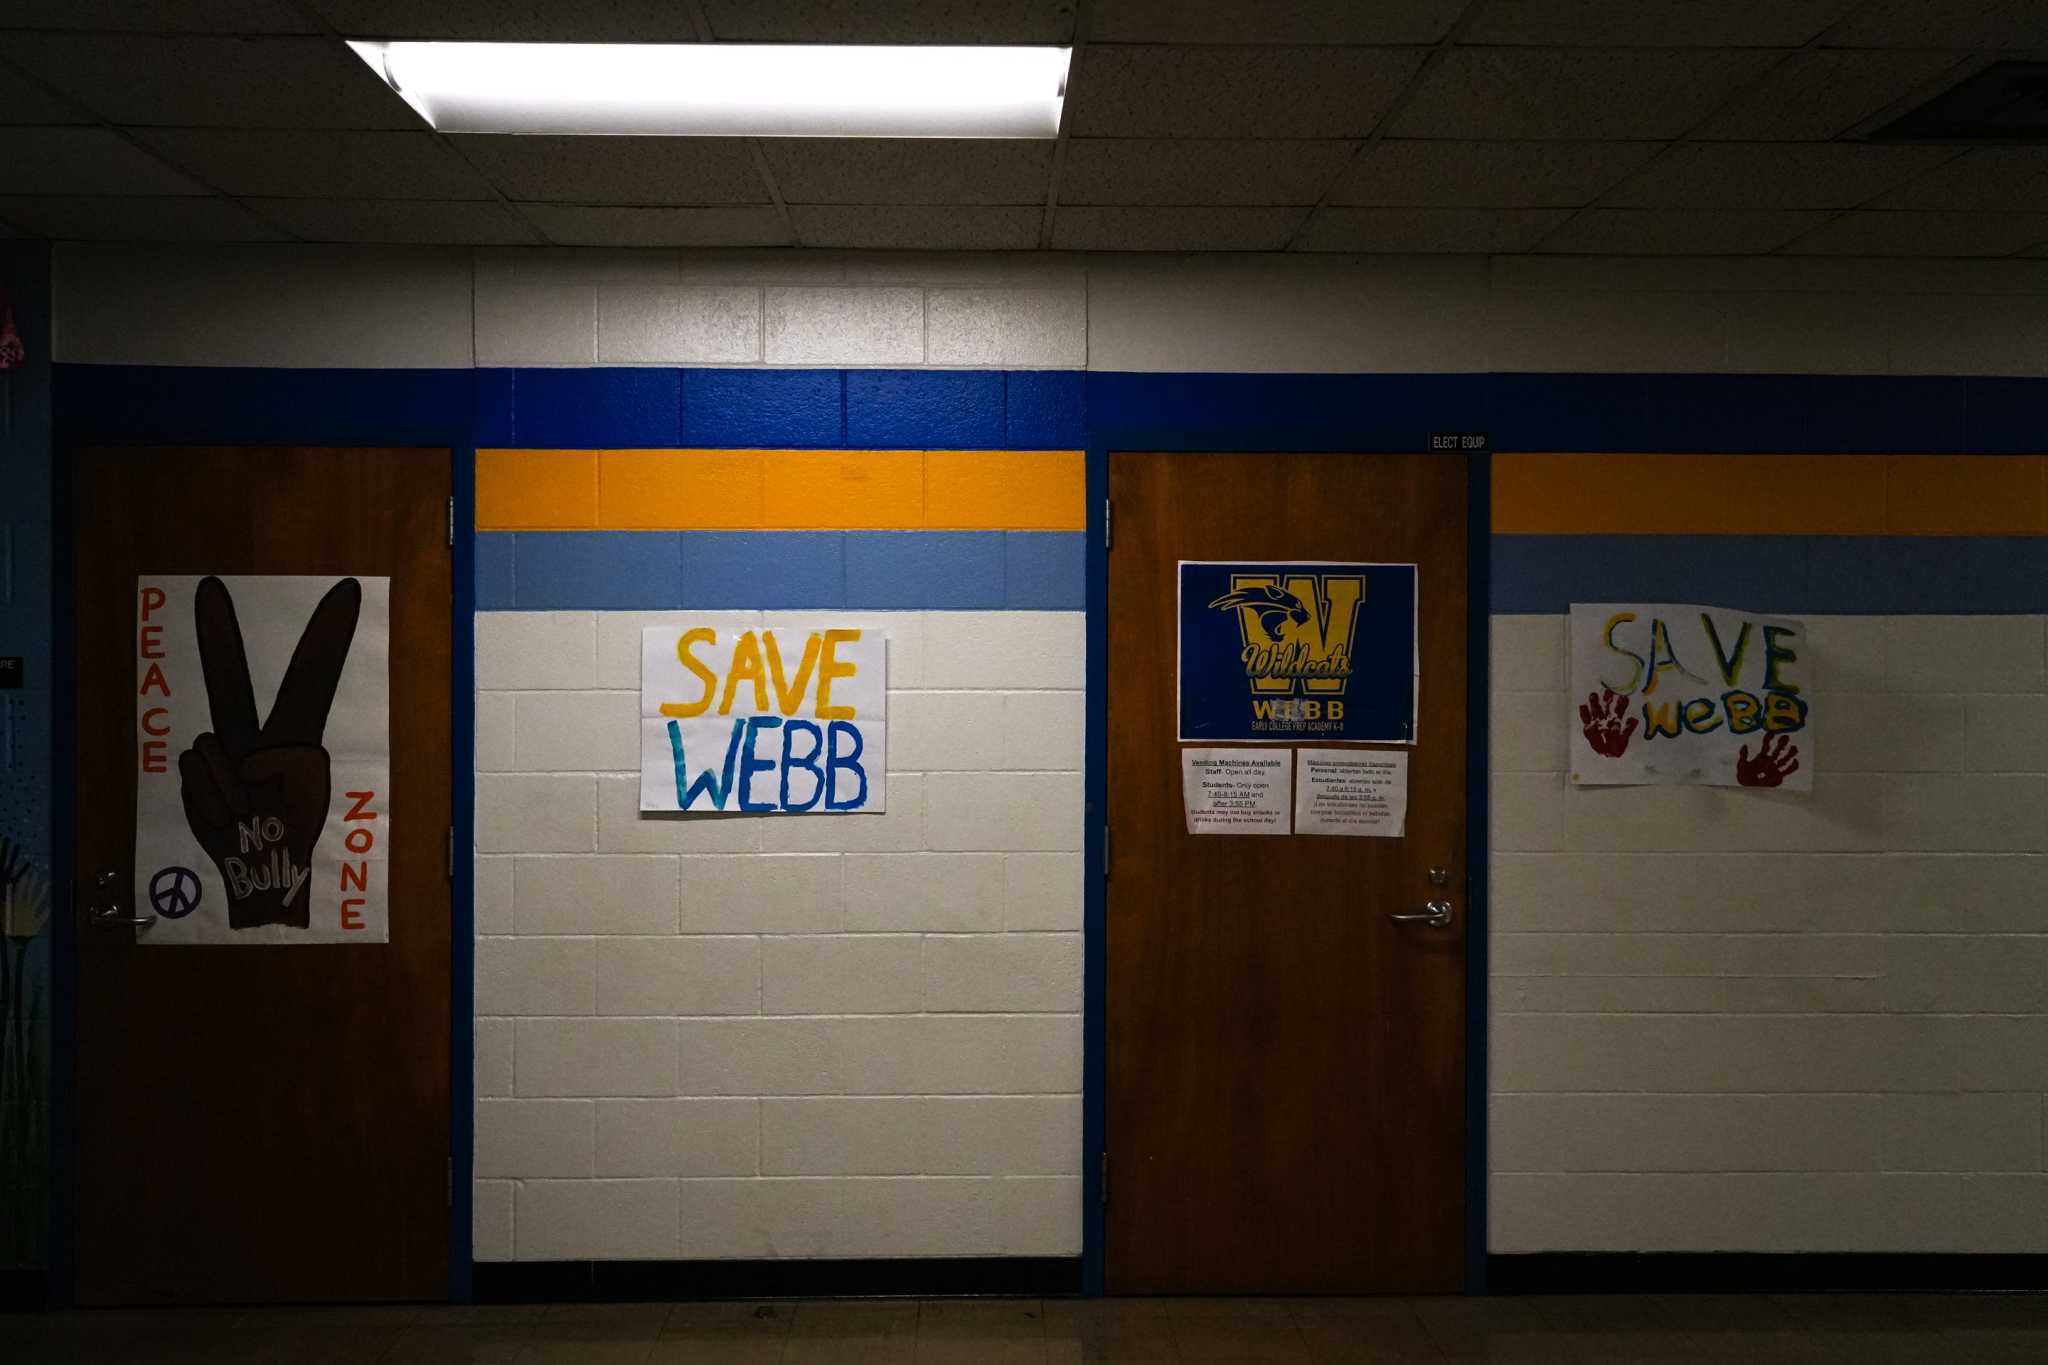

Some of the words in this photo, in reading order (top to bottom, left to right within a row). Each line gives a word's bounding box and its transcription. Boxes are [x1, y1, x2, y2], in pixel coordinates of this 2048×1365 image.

[1433, 435, 1458, 449] ELECT
[139, 587, 171, 773] PEACE
[659, 627, 861, 719] SAVE
[1241, 642, 1353, 680] Wildcats
[1601, 612, 1799, 696] SAVE
[667, 716, 867, 813] WEBB
[1236, 782, 1252, 790] Only
[1251, 760, 1281, 768] Available
[1253, 769, 1265, 777] day
[223, 845, 312, 908] Bully
[340, 791, 377, 930] ZONE
